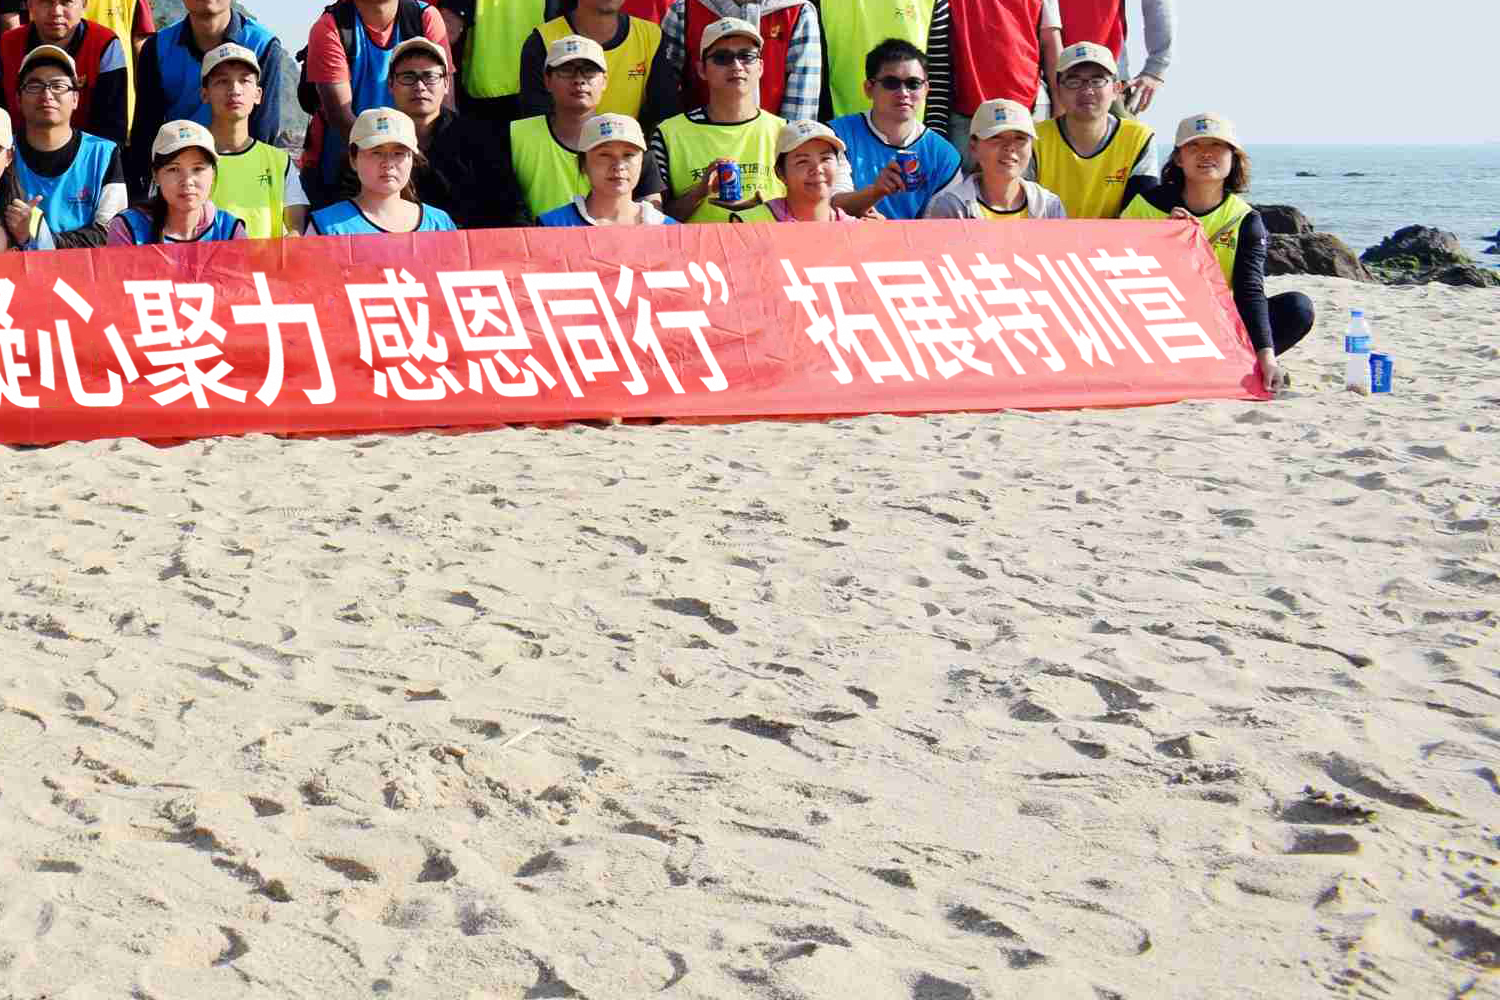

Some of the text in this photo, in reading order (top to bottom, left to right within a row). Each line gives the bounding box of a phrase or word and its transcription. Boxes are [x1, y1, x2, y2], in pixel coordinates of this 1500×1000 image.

[780, 248, 1226, 384] 拓展特训营
